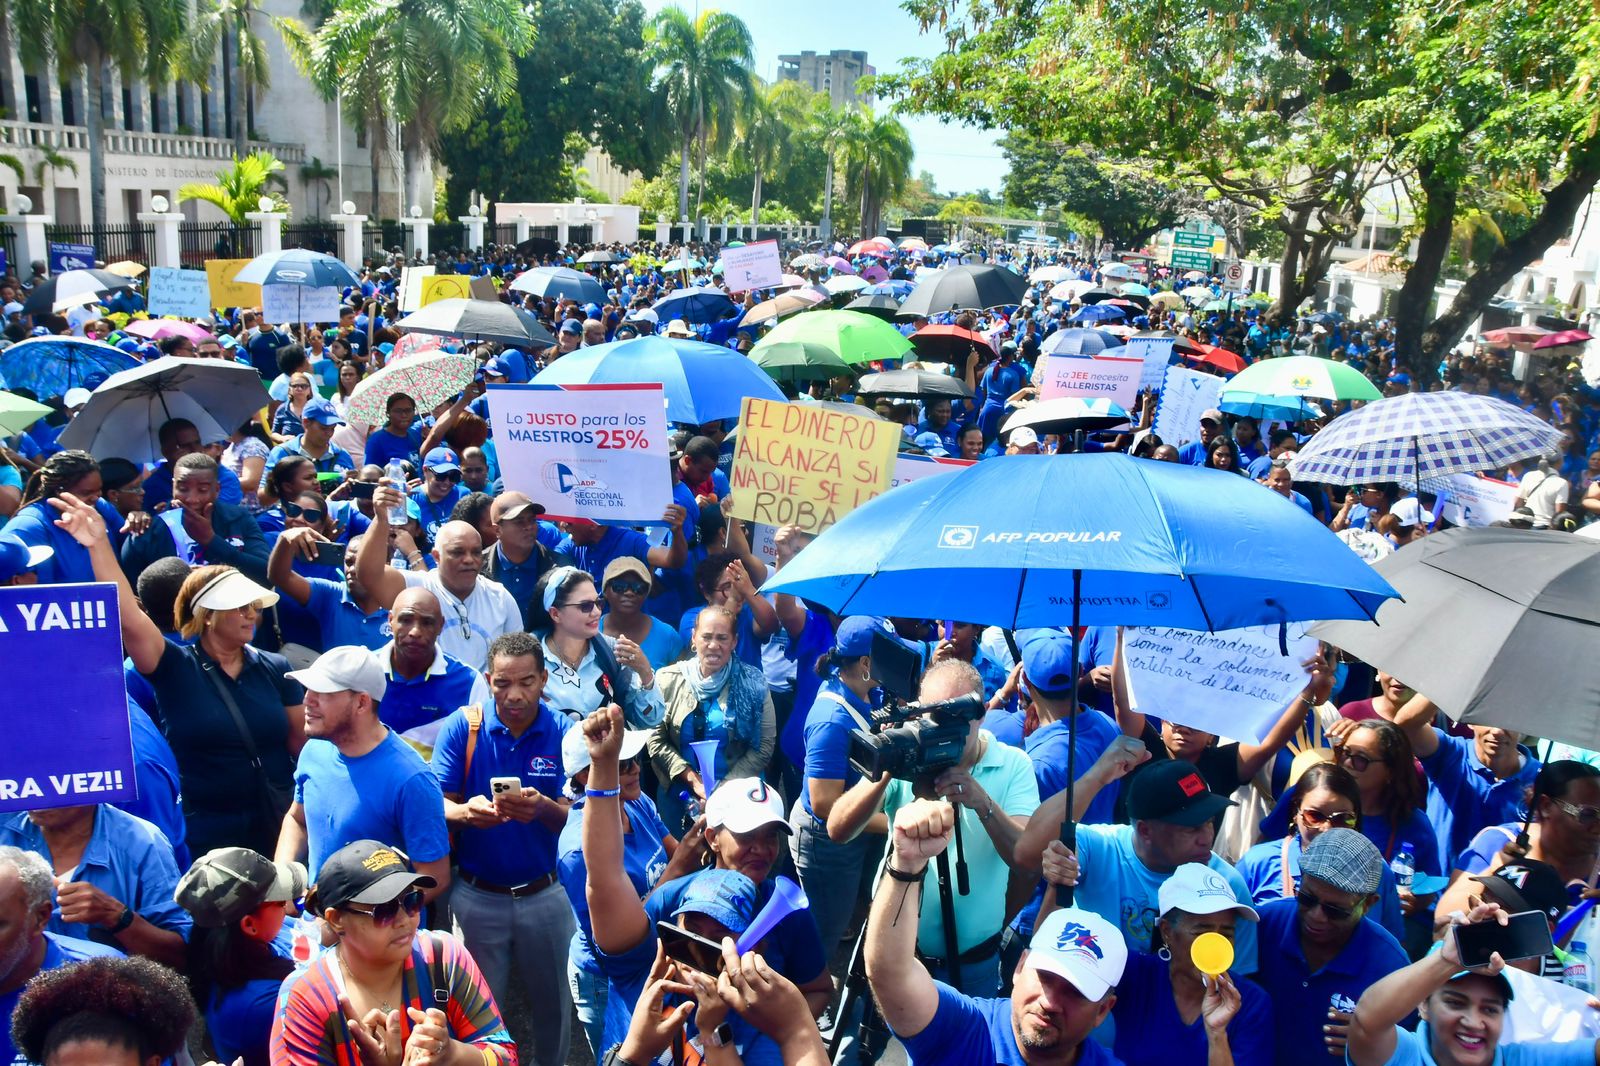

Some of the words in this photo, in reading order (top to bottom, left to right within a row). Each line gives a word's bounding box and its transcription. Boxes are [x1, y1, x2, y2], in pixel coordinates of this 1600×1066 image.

[155, 168, 166, 177] DE
[1056, 380, 1117, 391] TALLERISTAS
[1057, 371, 1069, 379] La
[1070, 371, 1089, 380] JEE
[1090, 373, 1129, 382] necesita
[506, 412, 523, 425] Lo
[526, 412, 577, 426] JUSTO
[581, 415, 619, 428] para
[624, 412, 646, 426] los
[745, 398, 773, 428] EL
[783, 404, 875, 451] DINERO
[508, 429, 594, 444] MAESTROS
[595, 429, 649, 449] 25%
[738, 435, 842, 478] ALCANZA
[852, 460, 878, 485] SI
[733, 465, 805, 497] NADIE
[813, 479, 843, 505] SE
[574, 491, 624, 500] SECCIONAL
[575, 498, 606, 508] NORTE,
[608, 500, 626, 508] D.N.
[981, 532, 1022, 543] AFP
[1024, 531, 1122, 543] POPULAR
[16, 600, 107, 632] YA!!!
[1164, 628, 1275, 658] coordinadores
[1128, 637, 1174, 655] somos
[1179, 649, 1205, 667] la
[1214, 655, 1298, 684] columna
[1199, 672, 1215, 687] de
[1220, 675, 1245, 692] las
[48, 769, 124, 795] VEZ!!
